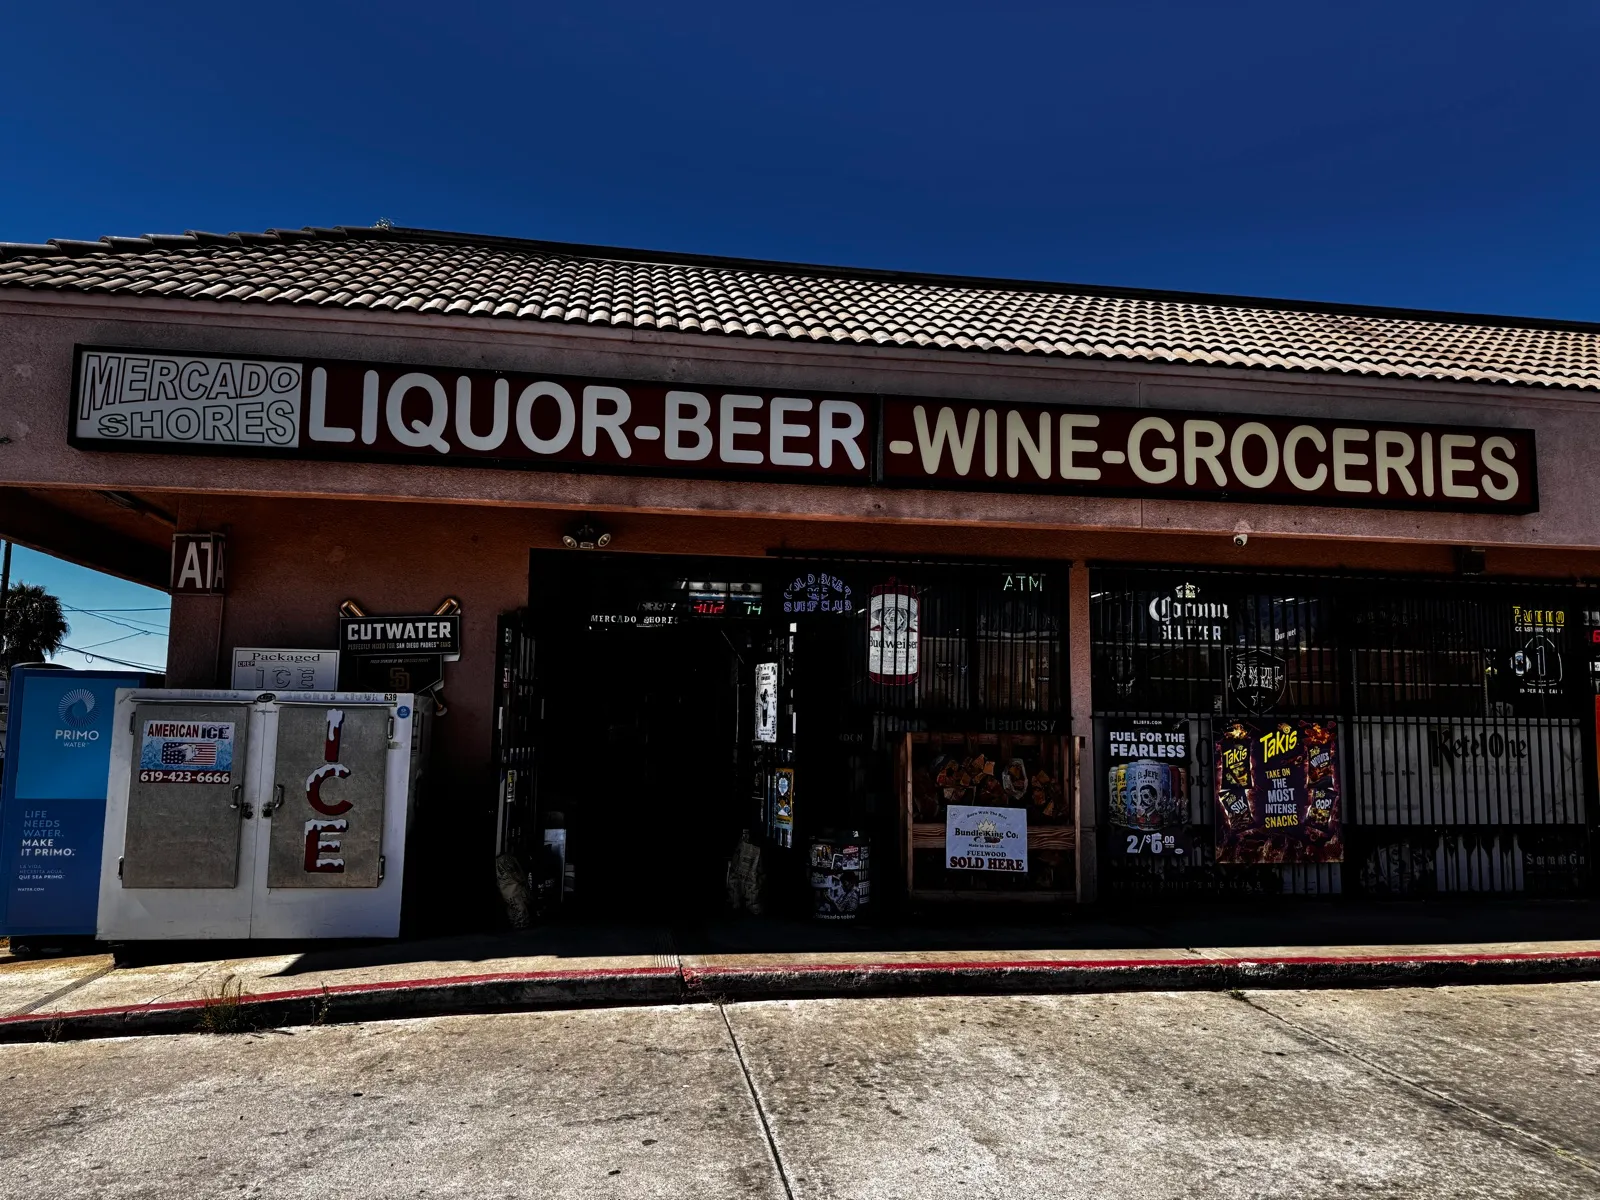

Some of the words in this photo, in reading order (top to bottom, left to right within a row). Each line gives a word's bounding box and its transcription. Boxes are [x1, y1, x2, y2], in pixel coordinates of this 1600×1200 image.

[80, 354, 300, 421] MERCADO
[98, 400, 295, 445] SHORES
[1003, 575, 1043, 592] ATM
[590, 614, 637, 624] MERCADO
[347, 621, 452, 641] CUTWATER
[395, 641, 405, 649] SAN
[252, 652, 321, 663] Packaged
[256, 666, 315, 689] ICE
[384, 693, 397, 701] 639
[55, 729, 100, 741] PRIMO
[148, 723, 199, 738] AMERICAN
[201, 726, 229, 739] ICE
[1109, 731, 1138, 742] FUEL
[1140, 732, 1162, 742] FOR
[1164, 733, 1186, 743] THE
[1110, 743, 1186, 758] FEARLESS
[1260, 730, 1299, 764] Takis
[140, 770, 230, 783] 619-423-6666
[1265, 769, 1281, 780] TAKE
[1282, 767, 1291, 777] ON
[1271, 777, 1288, 789] THE
[1267, 787, 1295, 803] MOST
[24, 810, 48, 819] LIFE
[1265, 803, 1297, 814] INTENSE
[23, 819, 61, 828] NEEDS
[1264, 814, 1299, 829] SNACKS
[23, 829, 65, 838] WATER.
[954, 827, 982, 837] Bundle
[985, 830, 1004, 839] King
[21, 838, 55, 847] MAKE
[20, 848, 32, 857] IT
[949, 856, 985, 869] SOLD
[987, 858, 1024, 871] HERE
